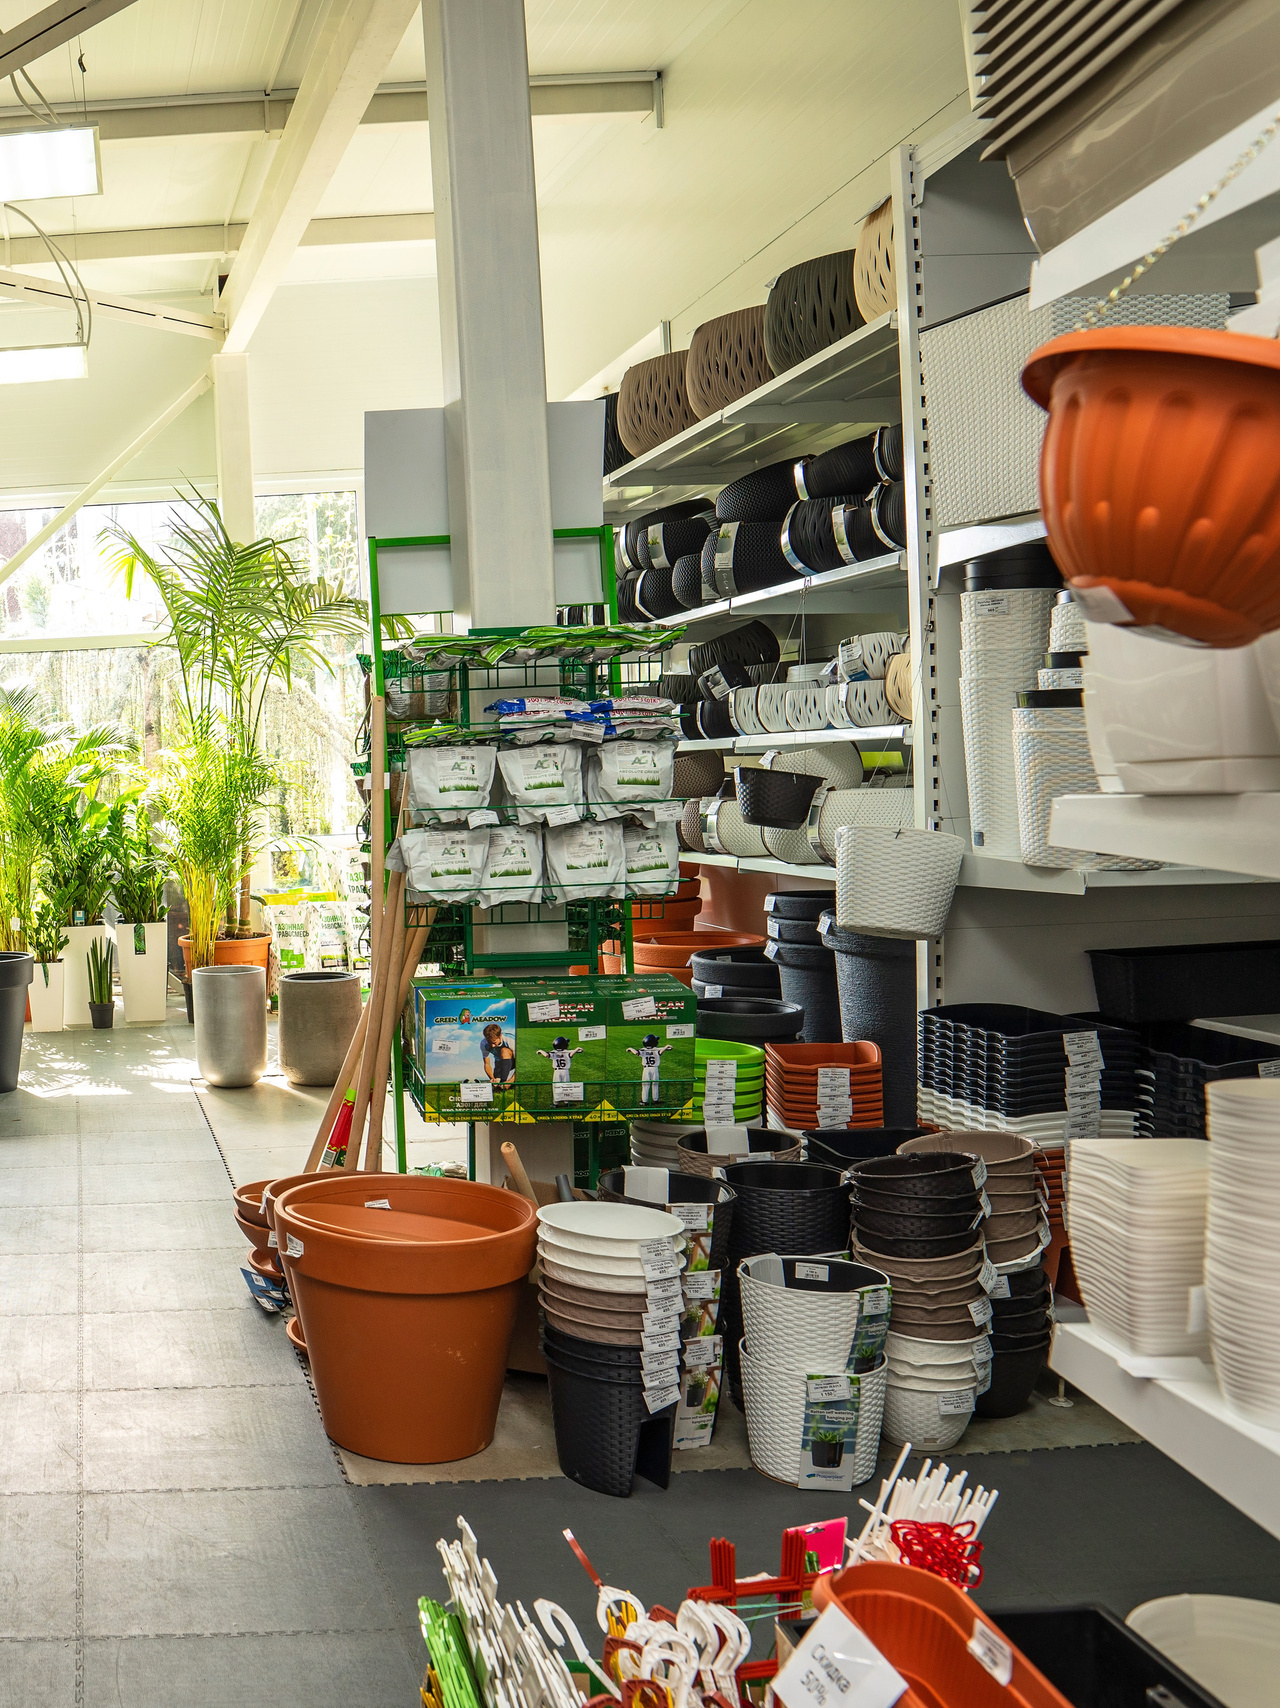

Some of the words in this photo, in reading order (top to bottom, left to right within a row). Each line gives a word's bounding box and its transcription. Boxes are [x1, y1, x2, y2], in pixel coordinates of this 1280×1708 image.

[275, 923, 305, 931] ГАЗОННАЯ
[434, 1016, 458, 1024] GREEN
[471, 1015, 507, 1023] MEADOW
[555, 1059, 567, 1068] 16
[645, 1056, 656, 1066] 16
[811, 1643, 851, 1694] Скидка
[800, 1669, 827, 1707] 50%
